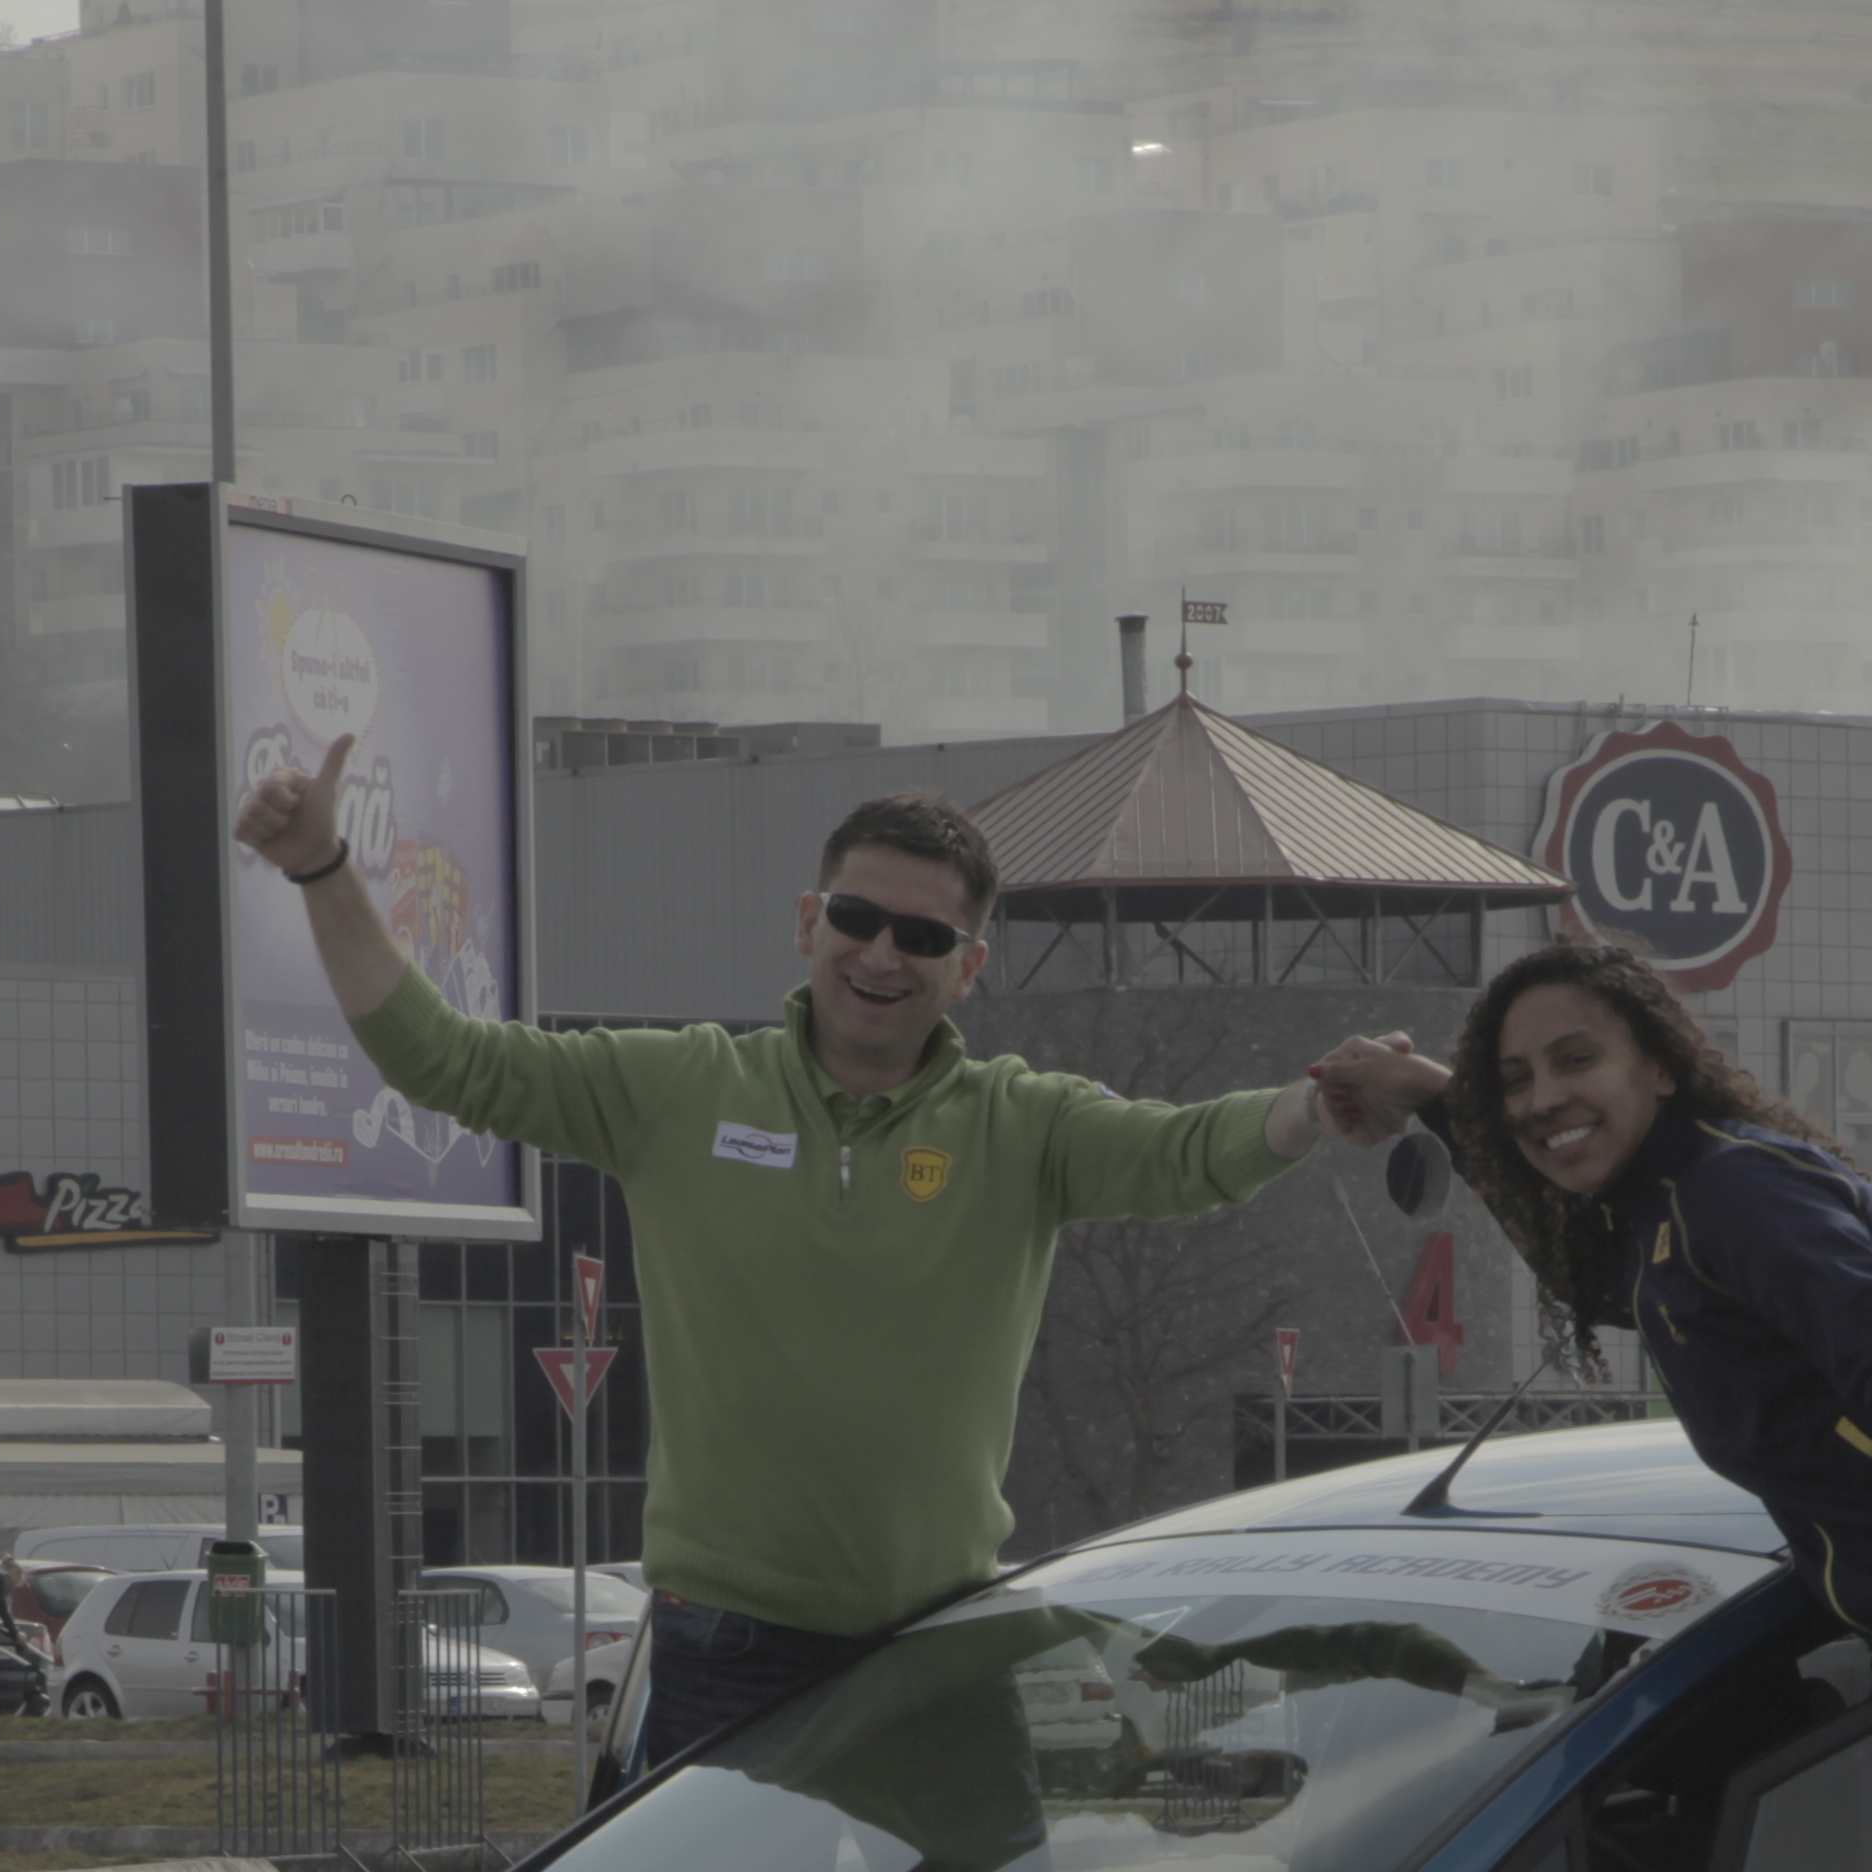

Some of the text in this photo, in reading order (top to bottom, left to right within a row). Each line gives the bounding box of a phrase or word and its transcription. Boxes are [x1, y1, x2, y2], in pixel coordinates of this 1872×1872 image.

[1187, 604, 1221, 621] 2007
[1591, 798, 1748, 914] C&A
[720, 1135, 792, 1155] LeasePlan
[910, 1163, 941, 1183] BT
[261, 1494, 280, 1524] P
[1153, 1554, 1332, 1577] RALLY
[1320, 1554, 1593, 1588] ACADEMY
